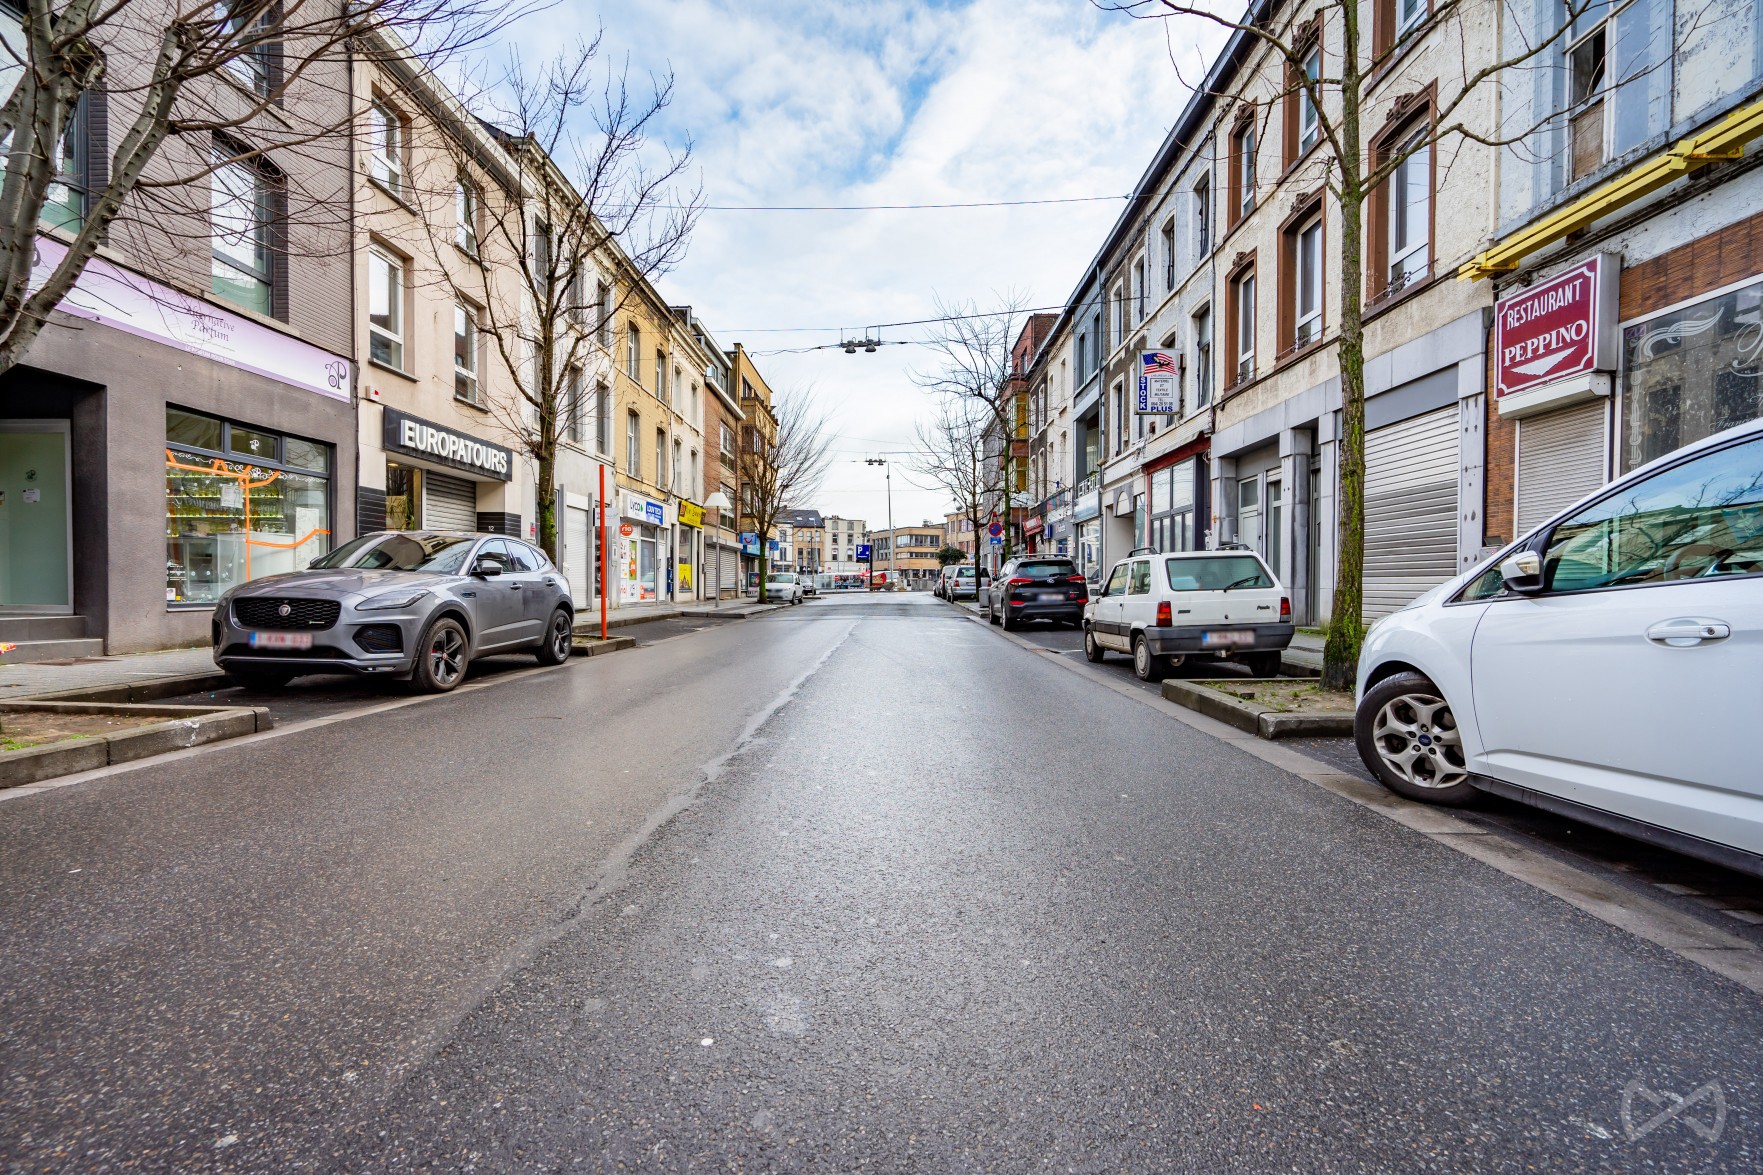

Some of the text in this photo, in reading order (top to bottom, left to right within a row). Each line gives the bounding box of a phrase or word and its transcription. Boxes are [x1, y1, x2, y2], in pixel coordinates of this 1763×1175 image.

[1506, 278, 1583, 331] RESTAURANT
[1503, 319, 1588, 367] PEPPINO
[400, 419, 508, 474] EUROPATOURS
[857, 546, 863, 555] P
